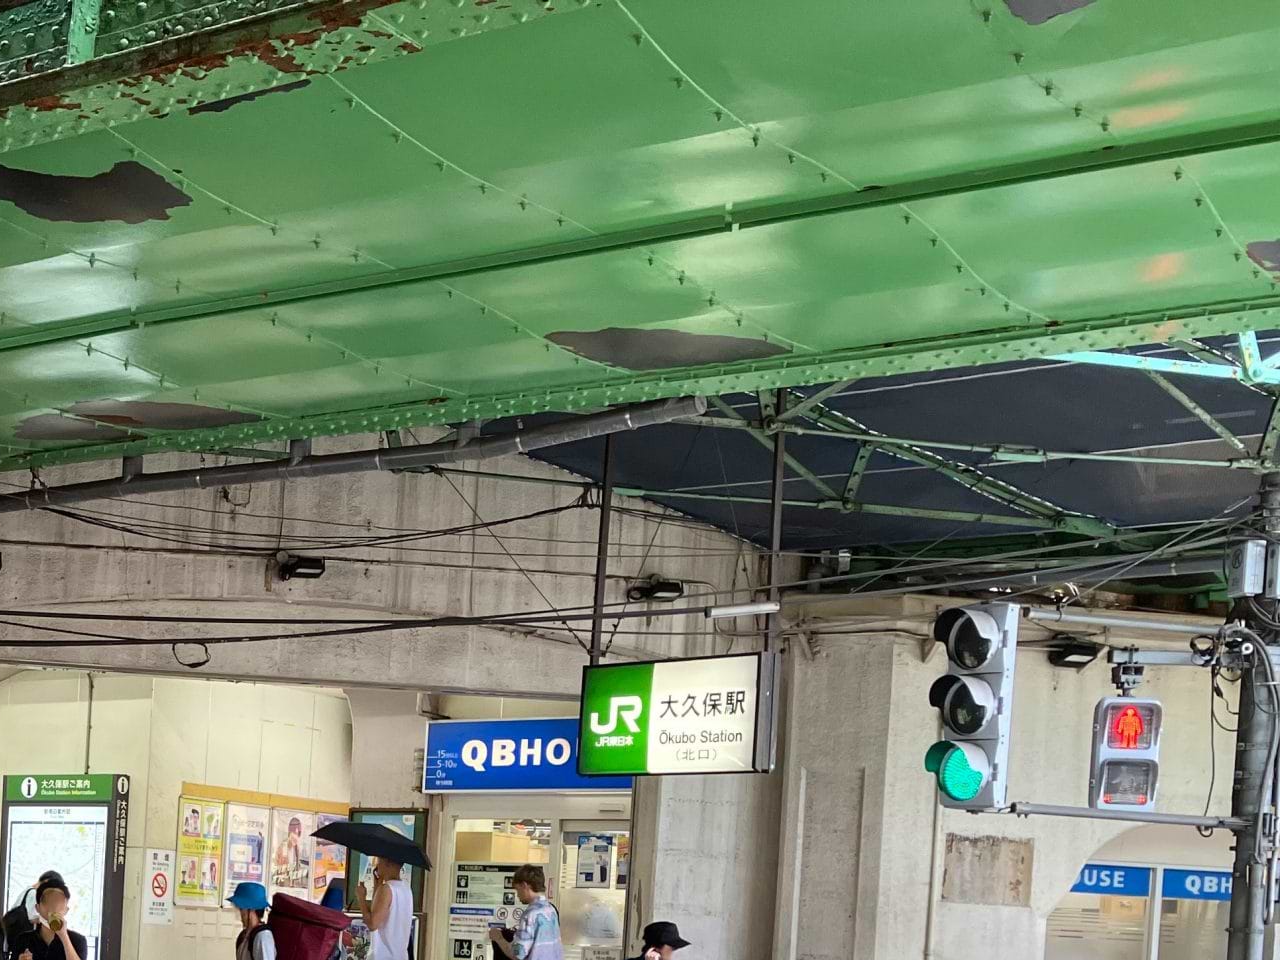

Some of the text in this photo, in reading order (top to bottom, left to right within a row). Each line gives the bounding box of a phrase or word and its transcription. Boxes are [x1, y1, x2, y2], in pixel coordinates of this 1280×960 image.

[659, 690, 746, 718] 大久保駅
[590, 695, 643, 735] JR
[659, 729, 743, 744] Ōkubo Station
[461, 737, 578, 772] QBHO
[40, 779, 91, 789] 大久保駅ご案内
[1074, 869, 1125, 888] USE
[1185, 874, 1233, 895] QBH
